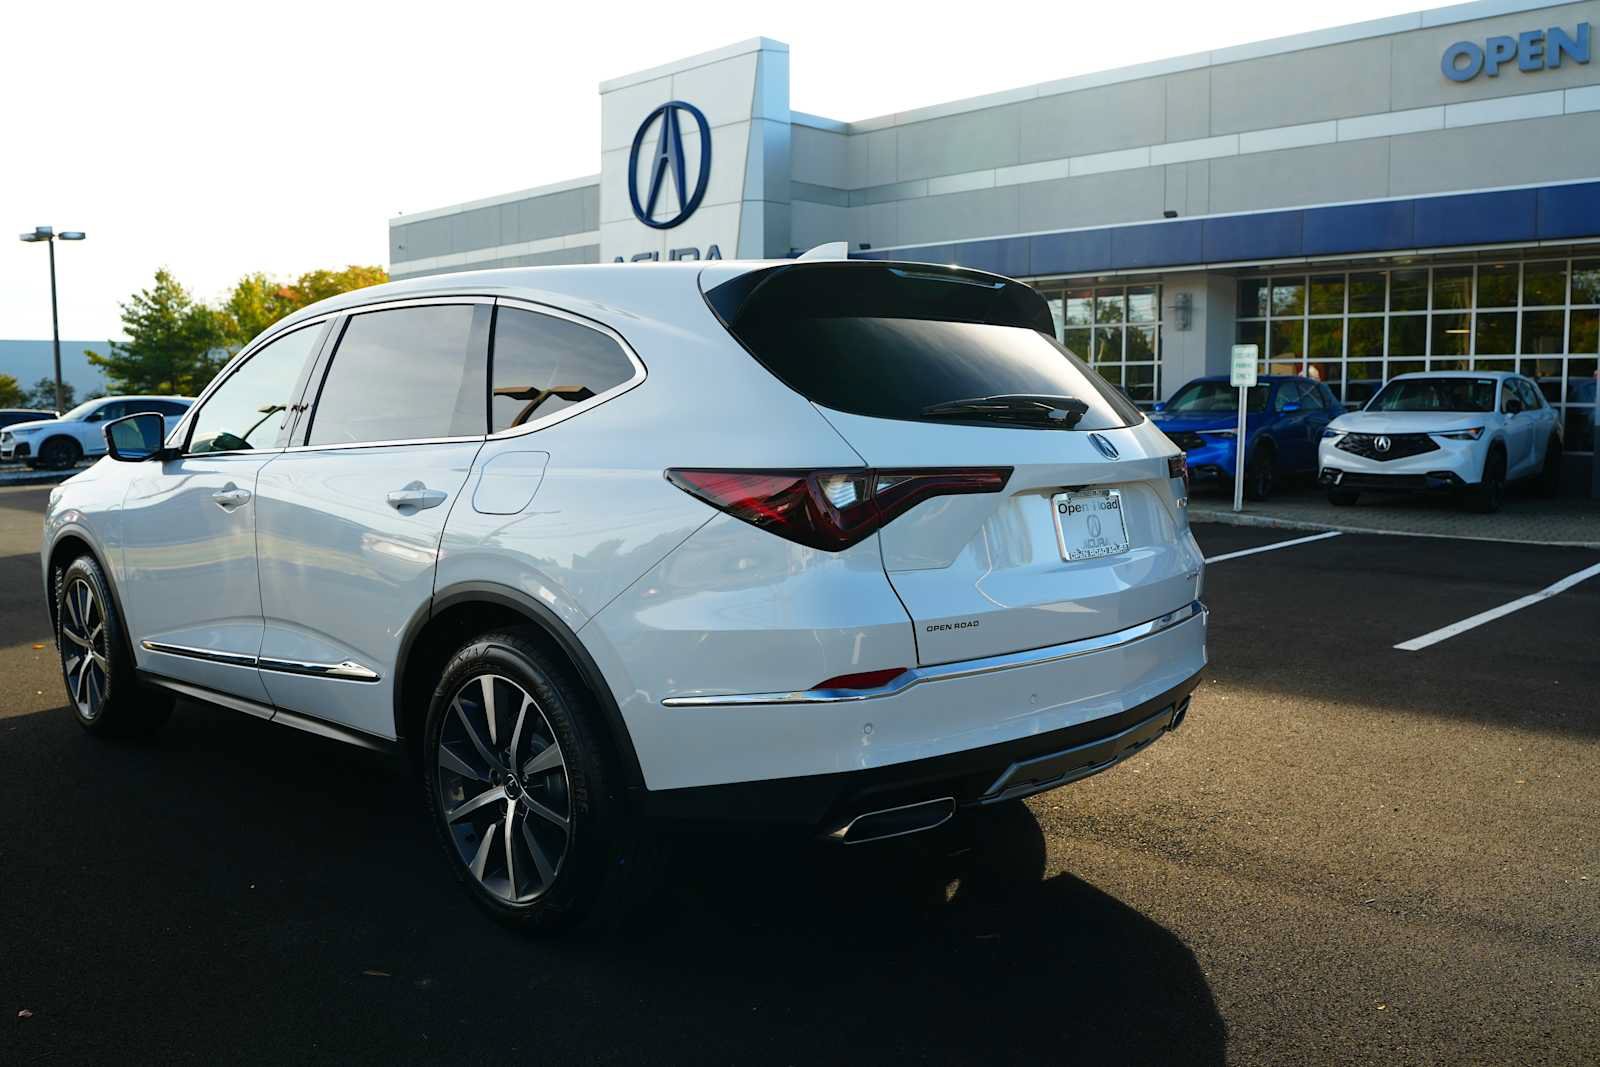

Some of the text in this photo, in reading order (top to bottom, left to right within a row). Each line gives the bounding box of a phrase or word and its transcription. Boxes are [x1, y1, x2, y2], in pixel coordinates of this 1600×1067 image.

[1441, 22, 1591, 83] OPEN
[613, 244, 722, 262] URA
[1058, 502, 1088, 516] Open
[926, 620, 979, 632] OPEN ROAD
